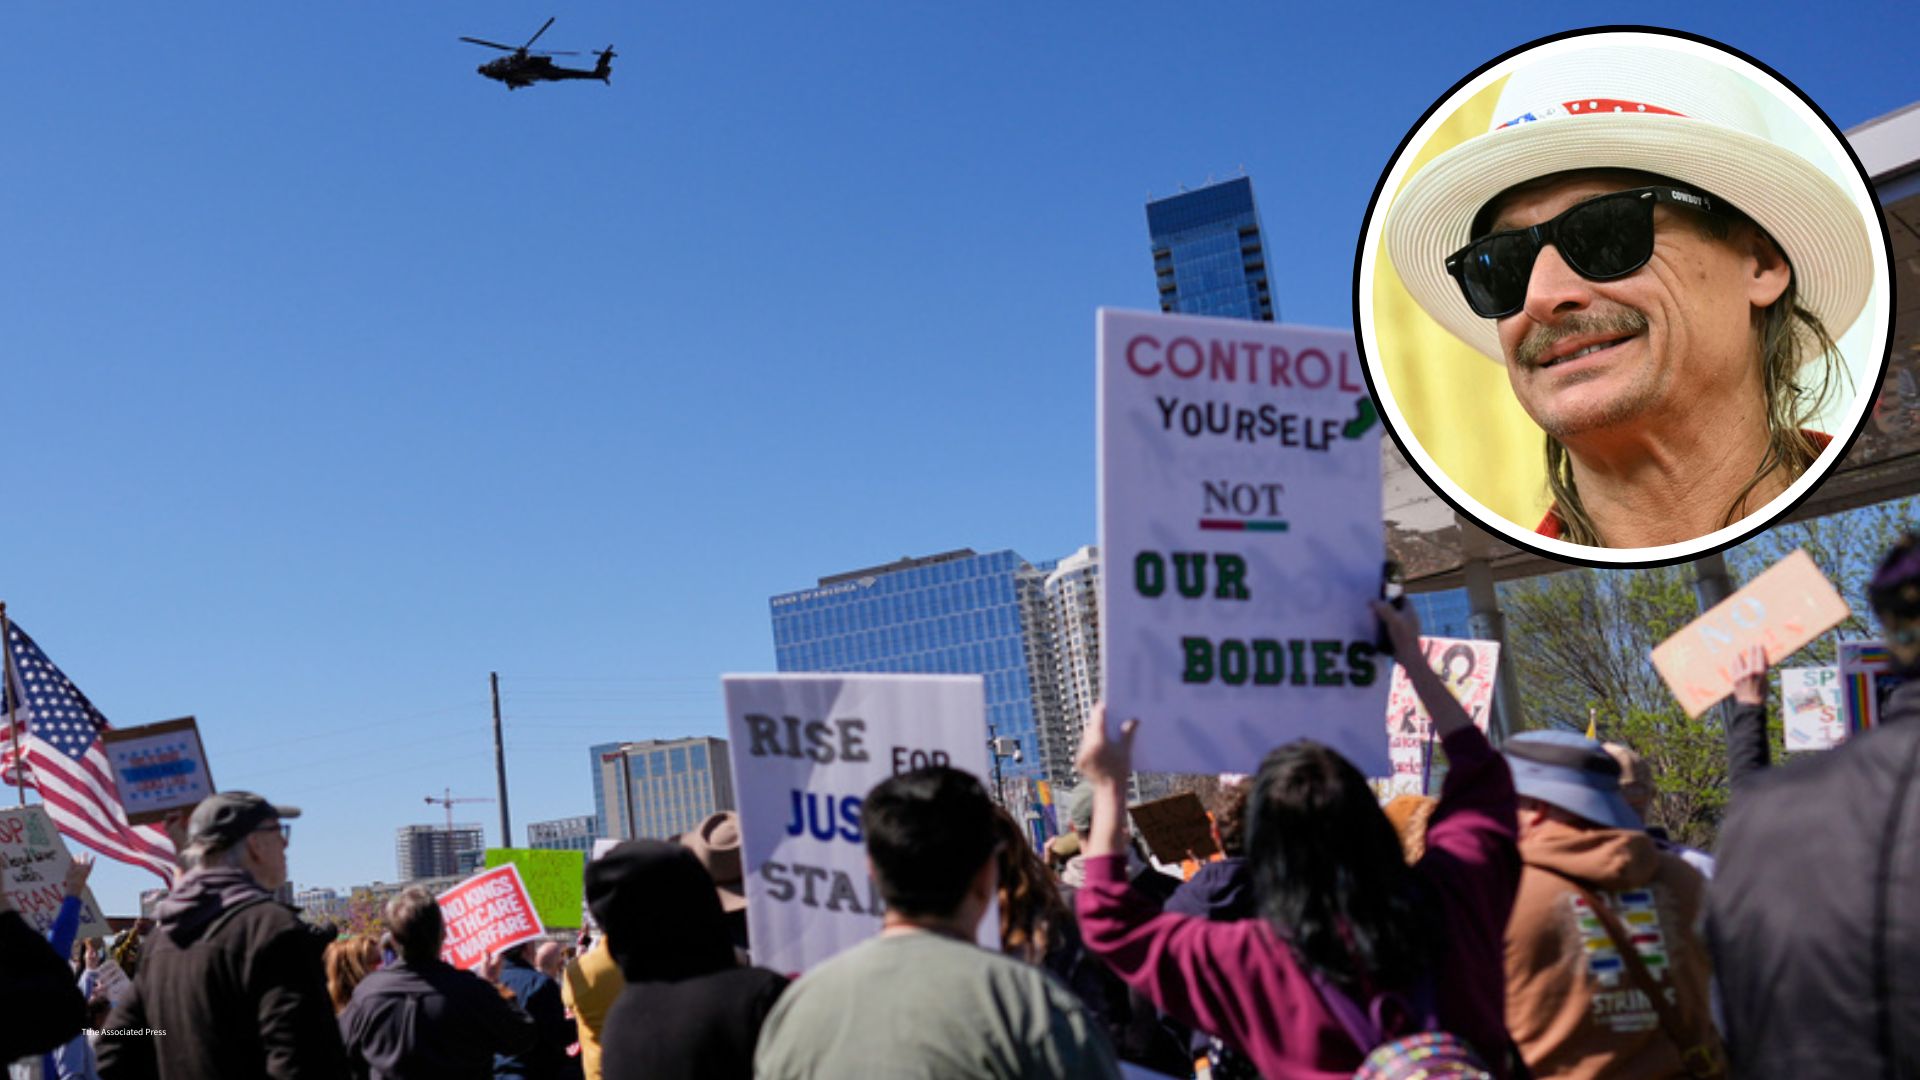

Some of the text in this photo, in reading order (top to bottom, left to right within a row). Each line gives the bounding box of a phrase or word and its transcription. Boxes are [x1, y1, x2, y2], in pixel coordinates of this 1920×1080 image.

[1125, 335, 1361, 393] CONTROL
[1156, 396, 1340, 451] YOURSELF
[1203, 480, 1284, 516] NOT
[1134, 551, 1250, 600] OUR
[1699, 596, 1767, 654] NO
[1181, 635, 1377, 688] BODIES
[744, 713, 870, 765] RISE
[786, 789, 865, 844] JUS
[463, 875, 515, 907] KINGS
[443, 893, 524, 945] LTHCARE
[454, 914, 532, 961] WARFARE
